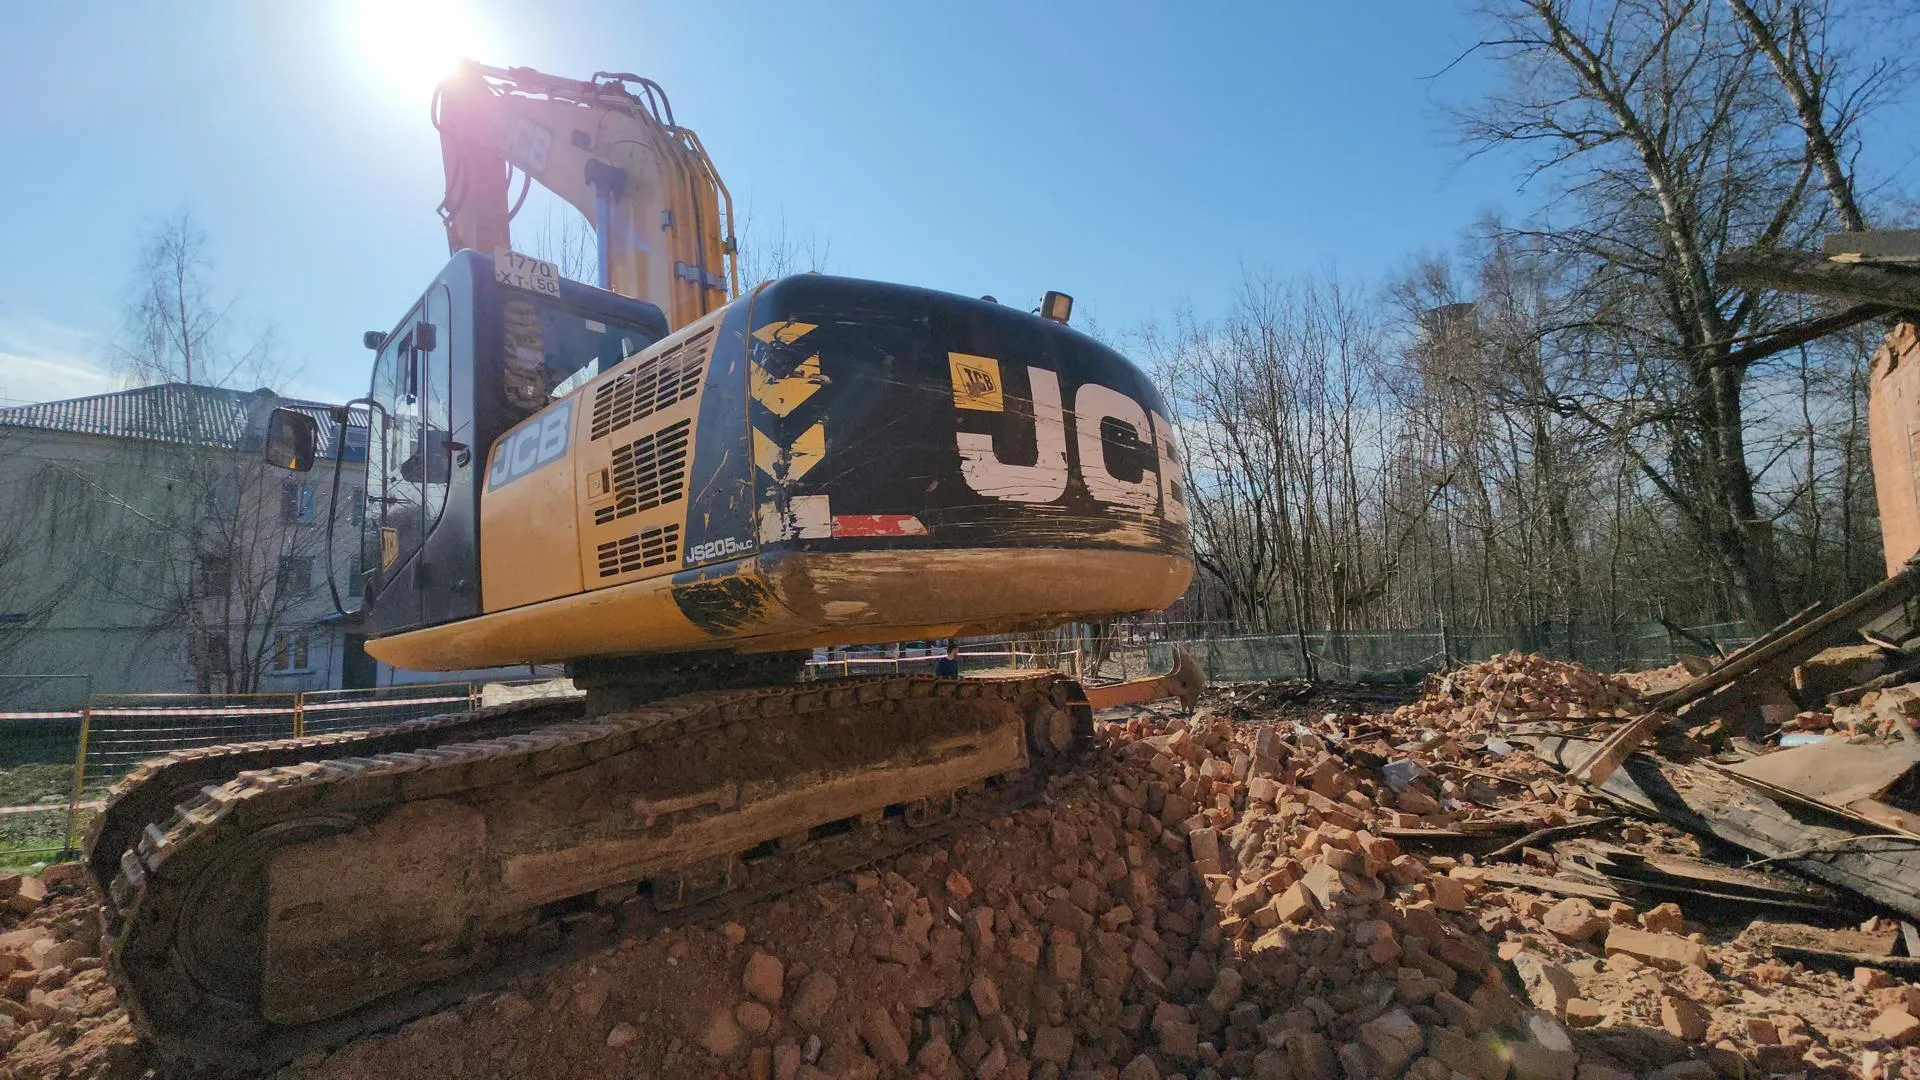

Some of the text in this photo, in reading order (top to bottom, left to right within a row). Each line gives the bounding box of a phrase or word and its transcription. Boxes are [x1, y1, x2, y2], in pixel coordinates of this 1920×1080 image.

[537, 278, 555, 293] 50
[491, 406, 569, 486] JCB
[956, 366, 1188, 524] JCB
